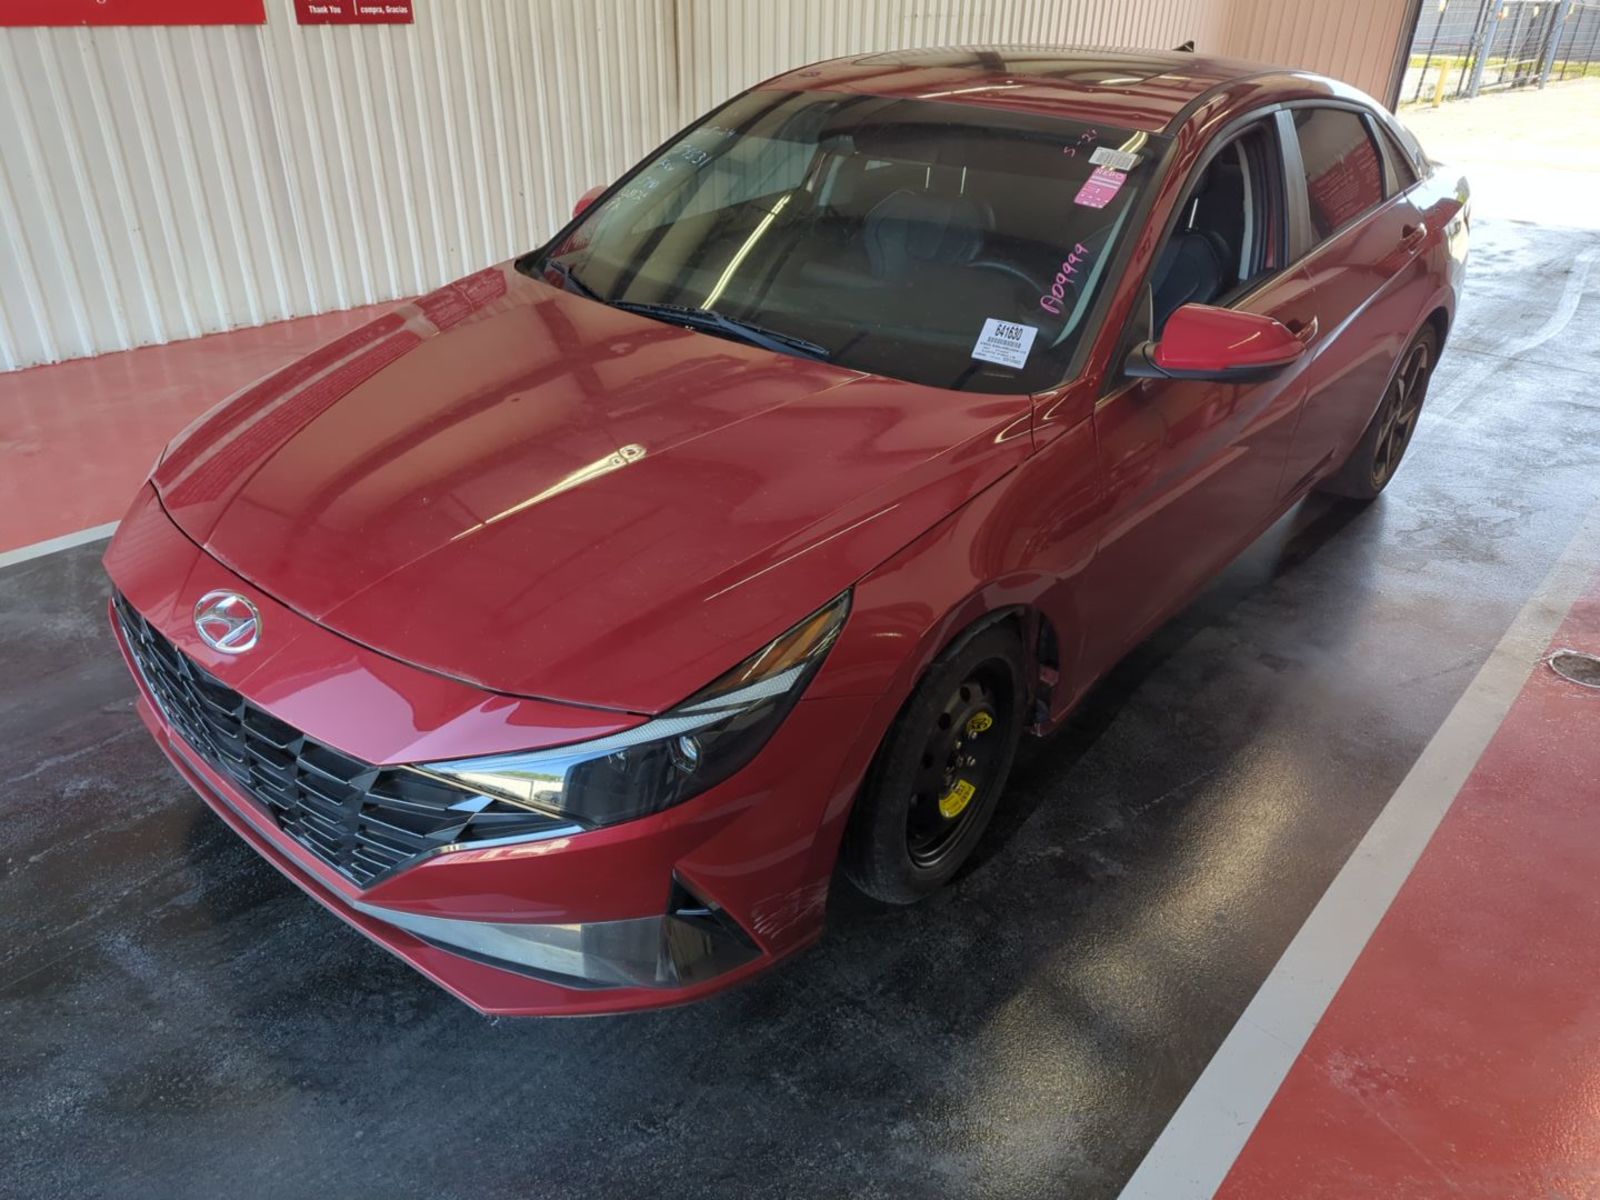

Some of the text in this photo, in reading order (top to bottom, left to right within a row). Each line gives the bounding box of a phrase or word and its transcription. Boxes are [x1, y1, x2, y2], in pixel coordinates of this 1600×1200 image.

[308, 5, 341, 13] Thank You
[385, 5, 408, 13] Gracias
